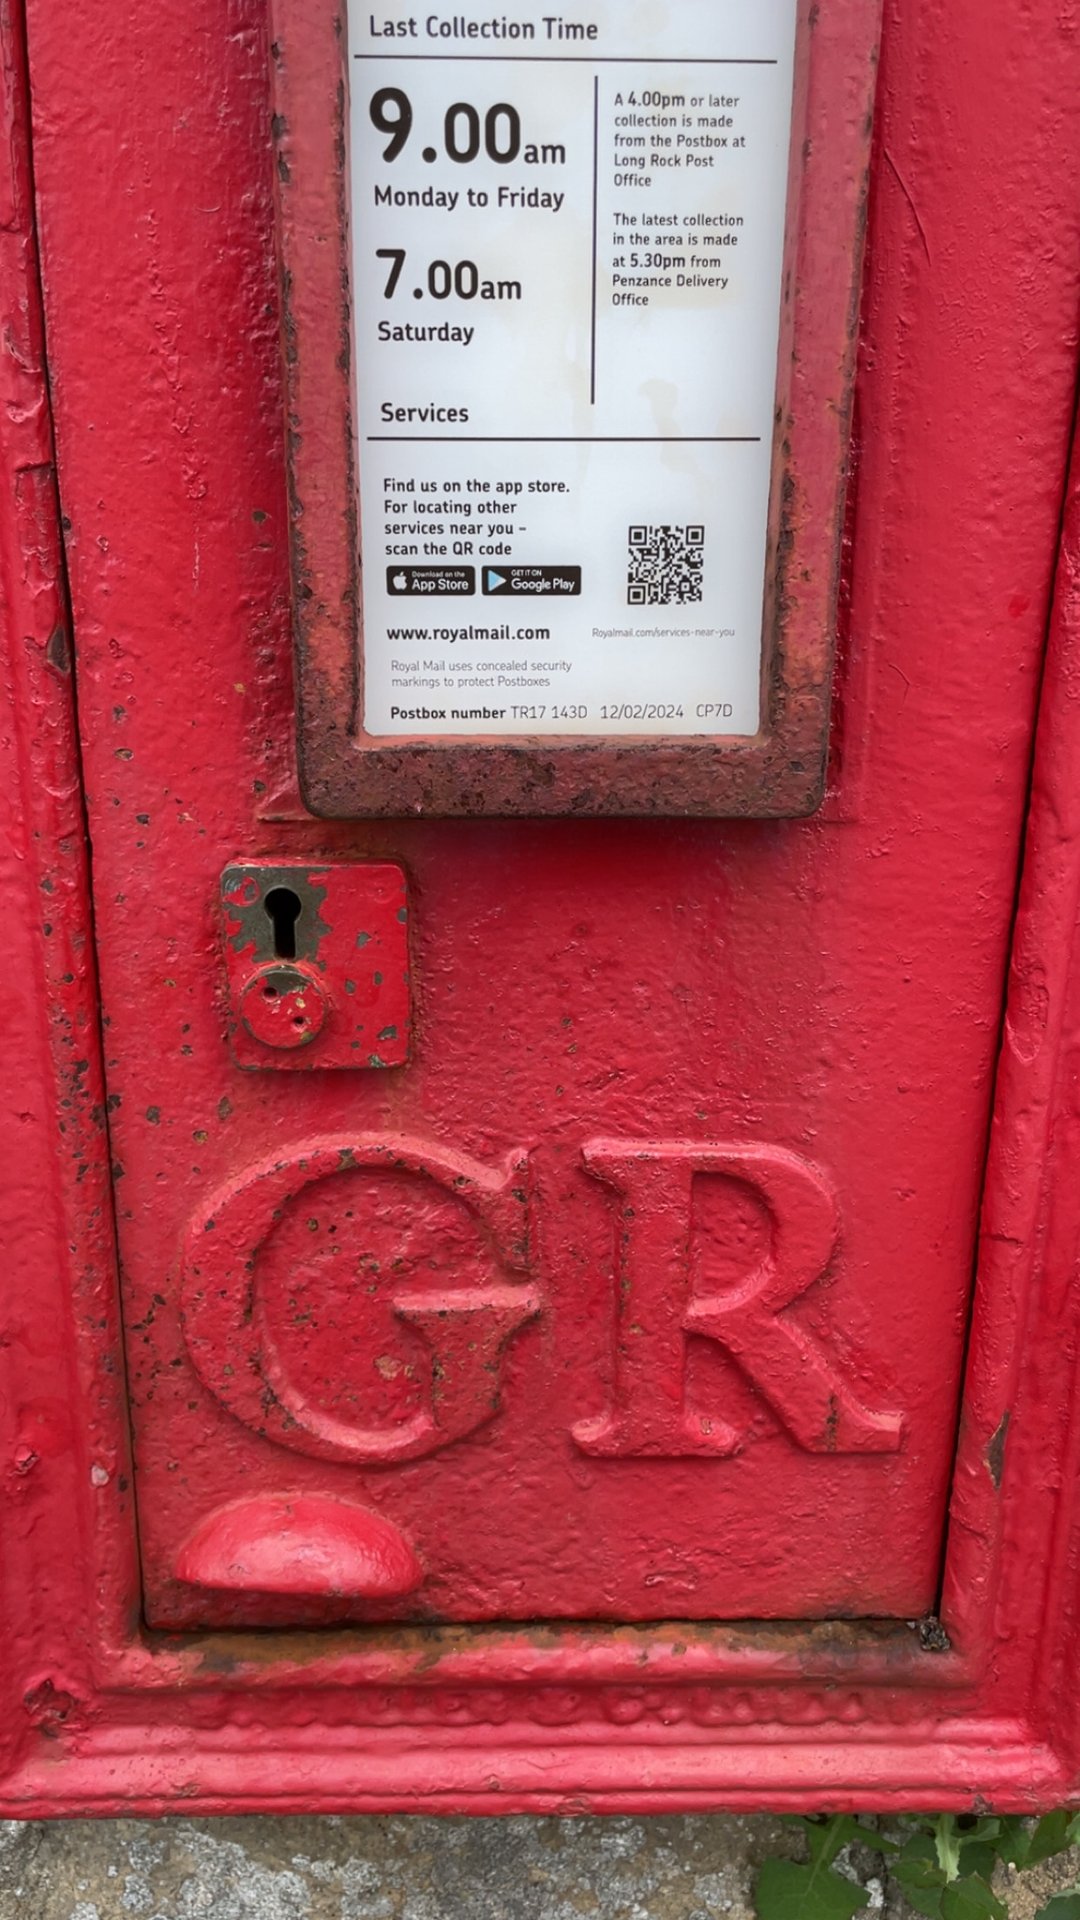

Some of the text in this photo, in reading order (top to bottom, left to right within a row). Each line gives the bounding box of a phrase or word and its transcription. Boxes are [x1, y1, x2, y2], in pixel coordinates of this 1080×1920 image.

[370, 15, 598, 40] Last Collection Time
[615, 91, 739, 109] A 4.00pm or later
[615, 114, 733, 127] collection is made
[615, 134, 745, 147] from the Postbox at
[615, 154, 713, 169] Long Rock Post
[614, 173, 651, 186] Office
[375, 185, 564, 211] Monday to Friday
[613, 213, 743, 226] The latest collection
[613, 232, 737, 245] in the area is made
[613, 253, 720, 270] at 5.30pm from
[613, 274, 728, 289] Penzance Delivery
[613, 293, 648, 305] Office
[378, 321, 474, 346] Saturday
[381, 402, 468, 422] Services
[384, 478, 569, 495] Find us on the app store.
[385, 500, 517, 517] For locating other
[385, 521, 444, 534] services
[450, 524, 483, 534] near
[488, 524, 513, 537] you
[385, 541, 511, 555] scan the QR code
[412, 578, 468, 592] App Store
[511, 578, 575, 592] Google Play
[387, 625, 550, 643] www.royalmail.com
[592, 627, 736, 638] Royalmail.com/services-near-you
[391, 660, 572, 673] Royal Mail uses concealed security
[392, 676, 550, 689] markings to protect Postboxes
[391, 704, 732, 720] Postbox number TR17 143D 12/02/2024 CP7D
[182, 1130, 904, 1465] GR
